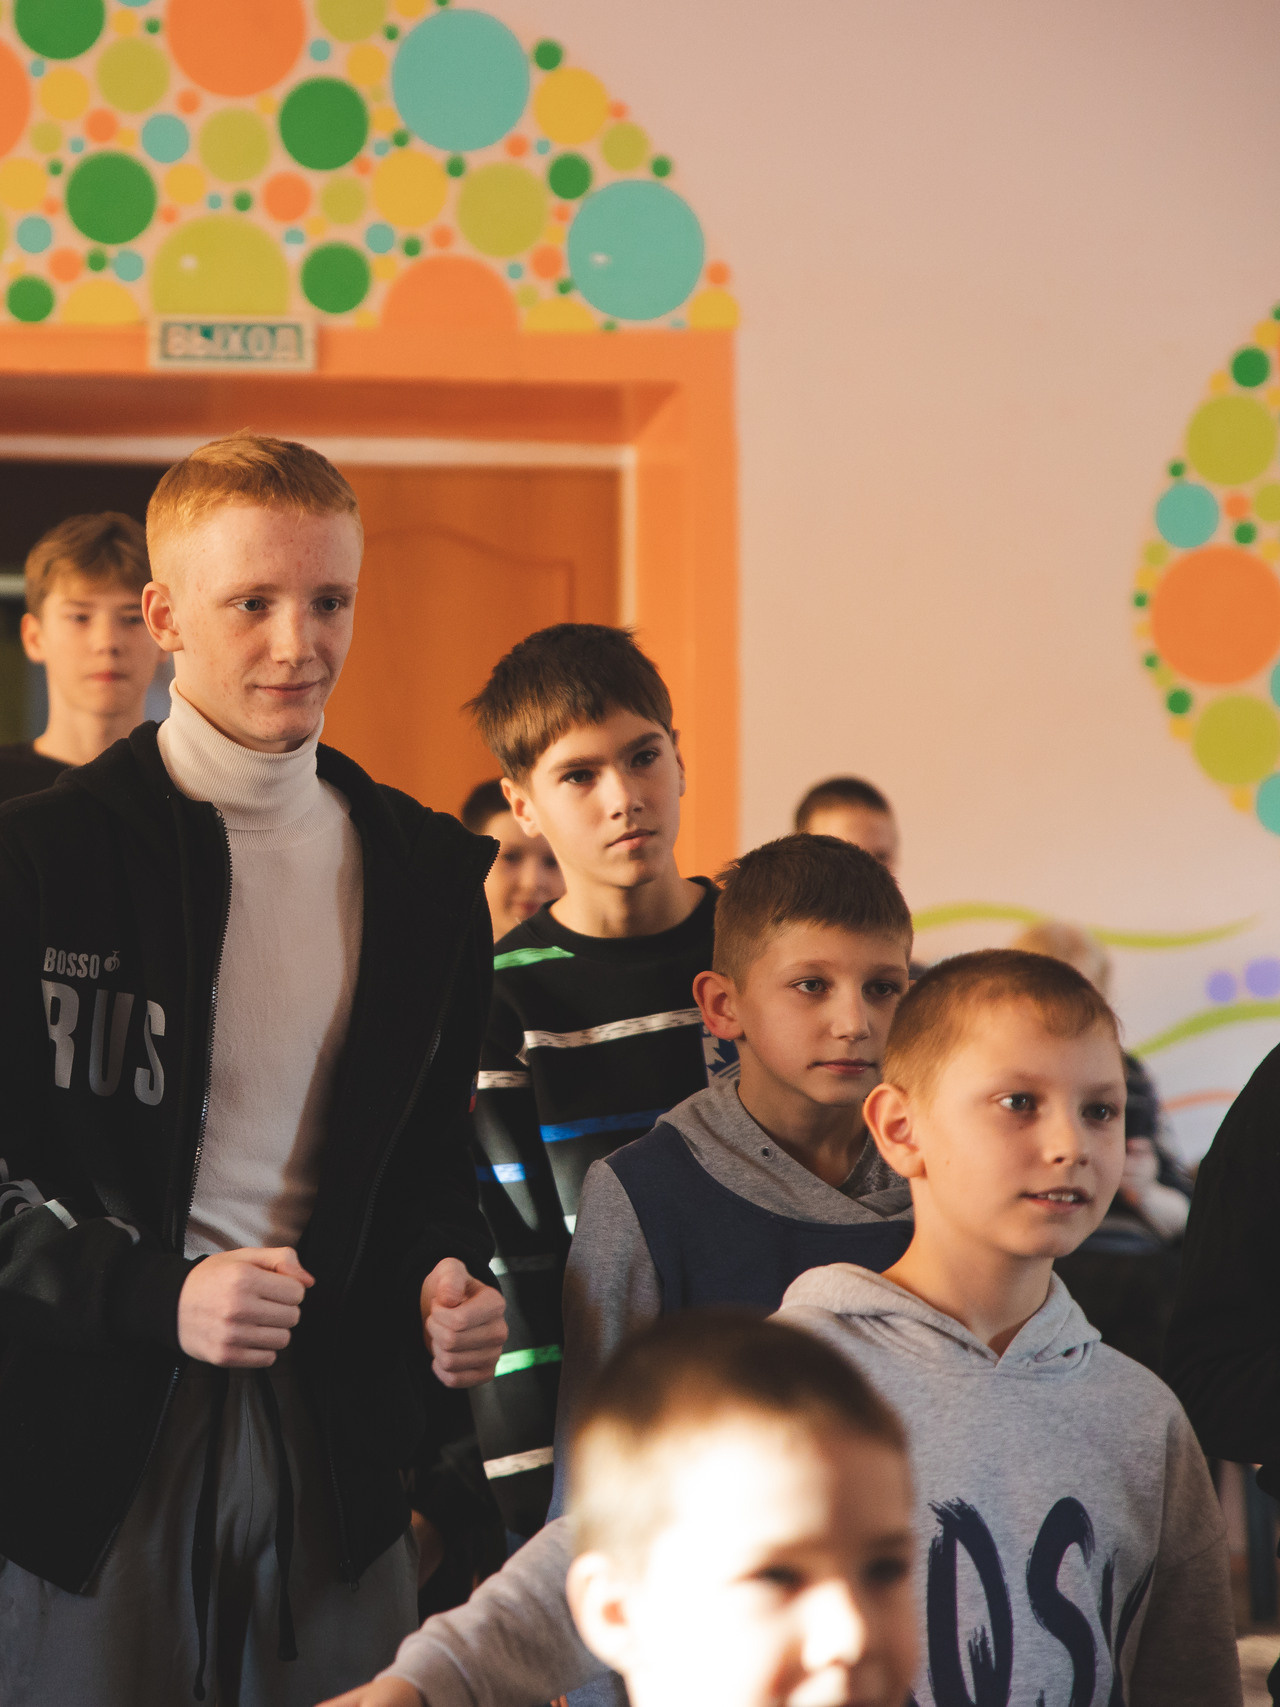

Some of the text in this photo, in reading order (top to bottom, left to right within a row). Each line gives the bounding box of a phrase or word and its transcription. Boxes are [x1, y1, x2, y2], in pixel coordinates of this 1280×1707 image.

[167, 326, 299, 357] ВЫХОД
[43, 947, 100, 980] BOSSO
[41, 979, 166, 1106] RUS
